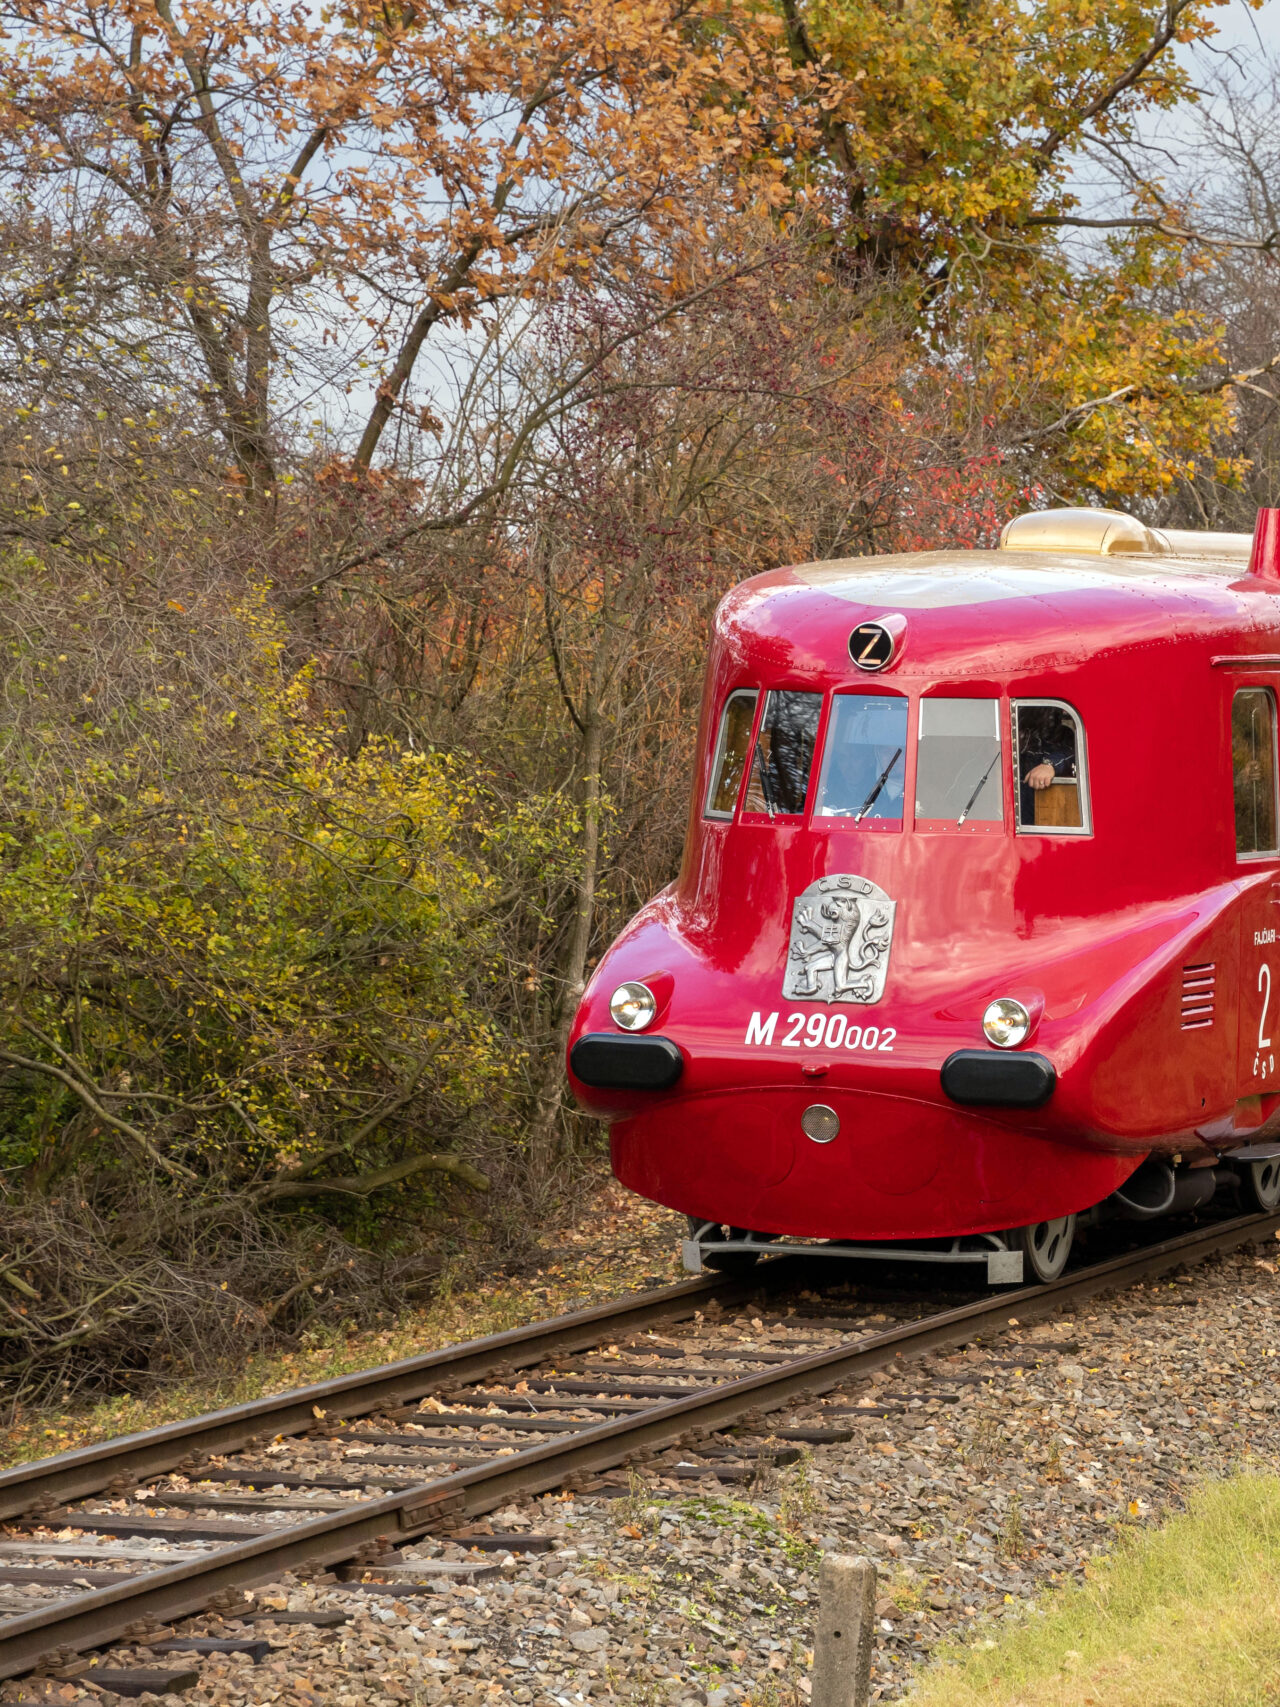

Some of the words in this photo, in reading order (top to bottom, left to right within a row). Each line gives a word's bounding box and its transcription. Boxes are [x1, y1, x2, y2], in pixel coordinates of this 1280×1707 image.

[858, 627, 882, 664] Z
[1258, 963, 1271, 1048] 2
[744, 1011, 779, 1046] M
